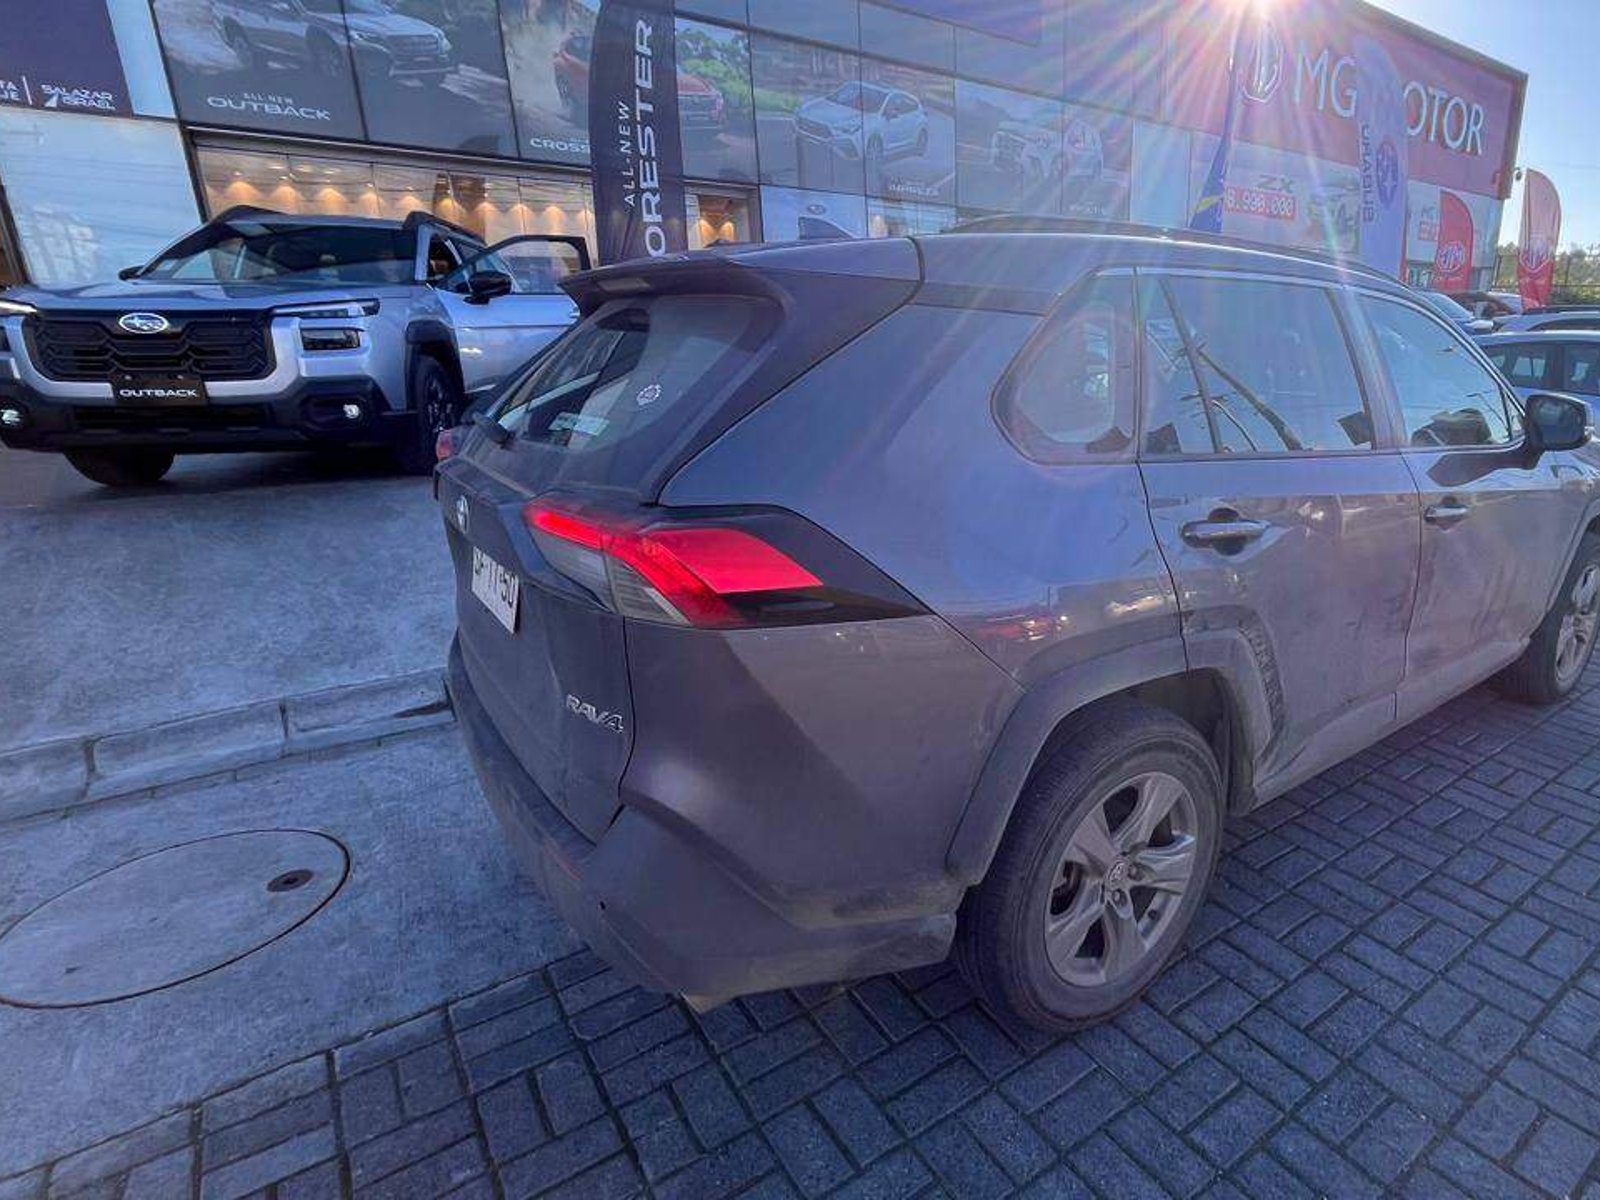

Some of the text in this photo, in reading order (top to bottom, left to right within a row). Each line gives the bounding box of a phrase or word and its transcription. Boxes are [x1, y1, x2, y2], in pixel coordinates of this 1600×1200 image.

[206, 96, 331, 121] OUTBACK
[635, 19, 666, 257] ORESTER
[1294, 46, 1358, 119] MG
[1403, 80, 1485, 156] OTOR
[618, 99, 636, 207] ALL-NEW
[119, 388, 198, 398] OUTBACK
[566, 693, 624, 734] RAV4
